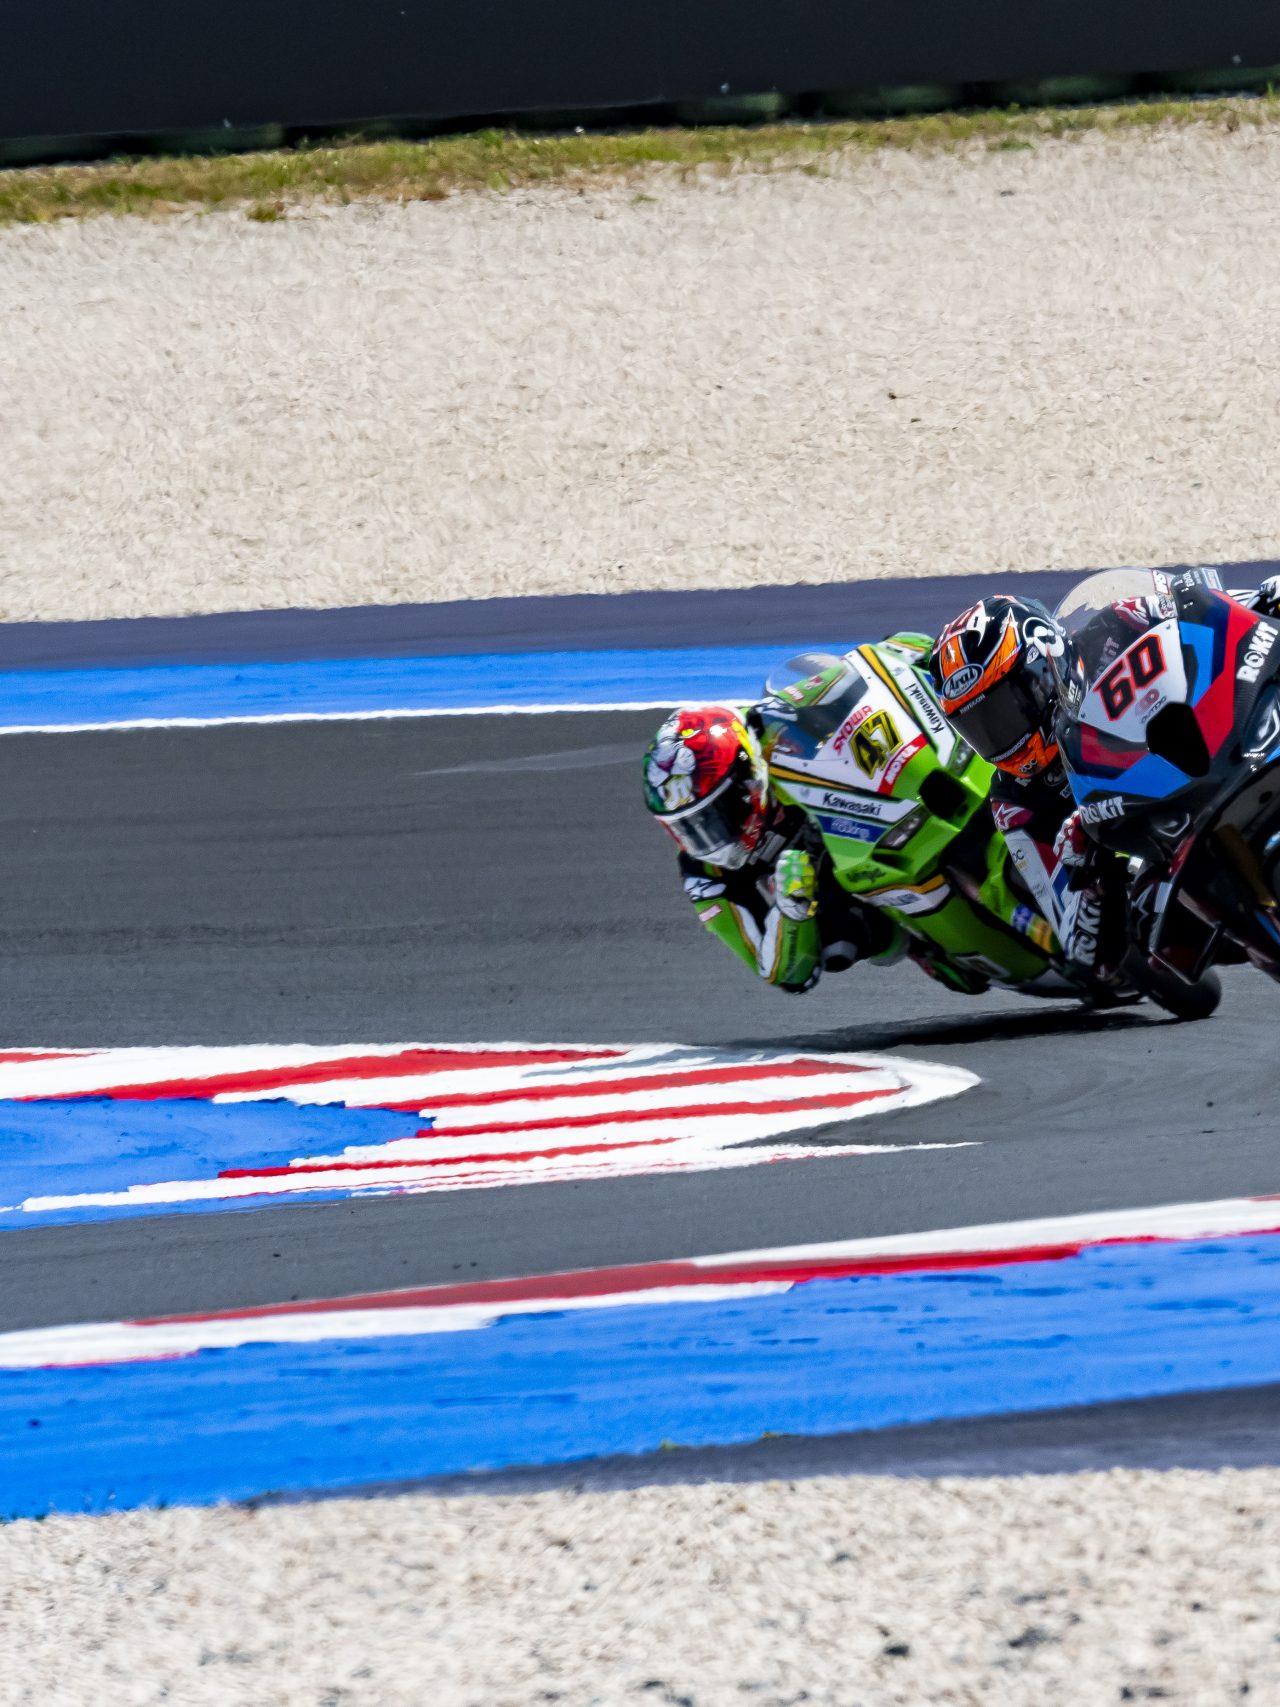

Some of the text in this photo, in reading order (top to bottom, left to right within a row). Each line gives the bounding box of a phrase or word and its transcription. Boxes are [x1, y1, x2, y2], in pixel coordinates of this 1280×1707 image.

[947, 666, 976, 693] Arai
[1093, 634, 1168, 721] 60
[832, 705, 873, 756] SHOWA
[904, 683, 945, 733] Kawasaki
[850, 709, 903, 780] 47
[885, 744, 920, 785] MOTUL
[822, 792, 882, 816] Kawasaki
